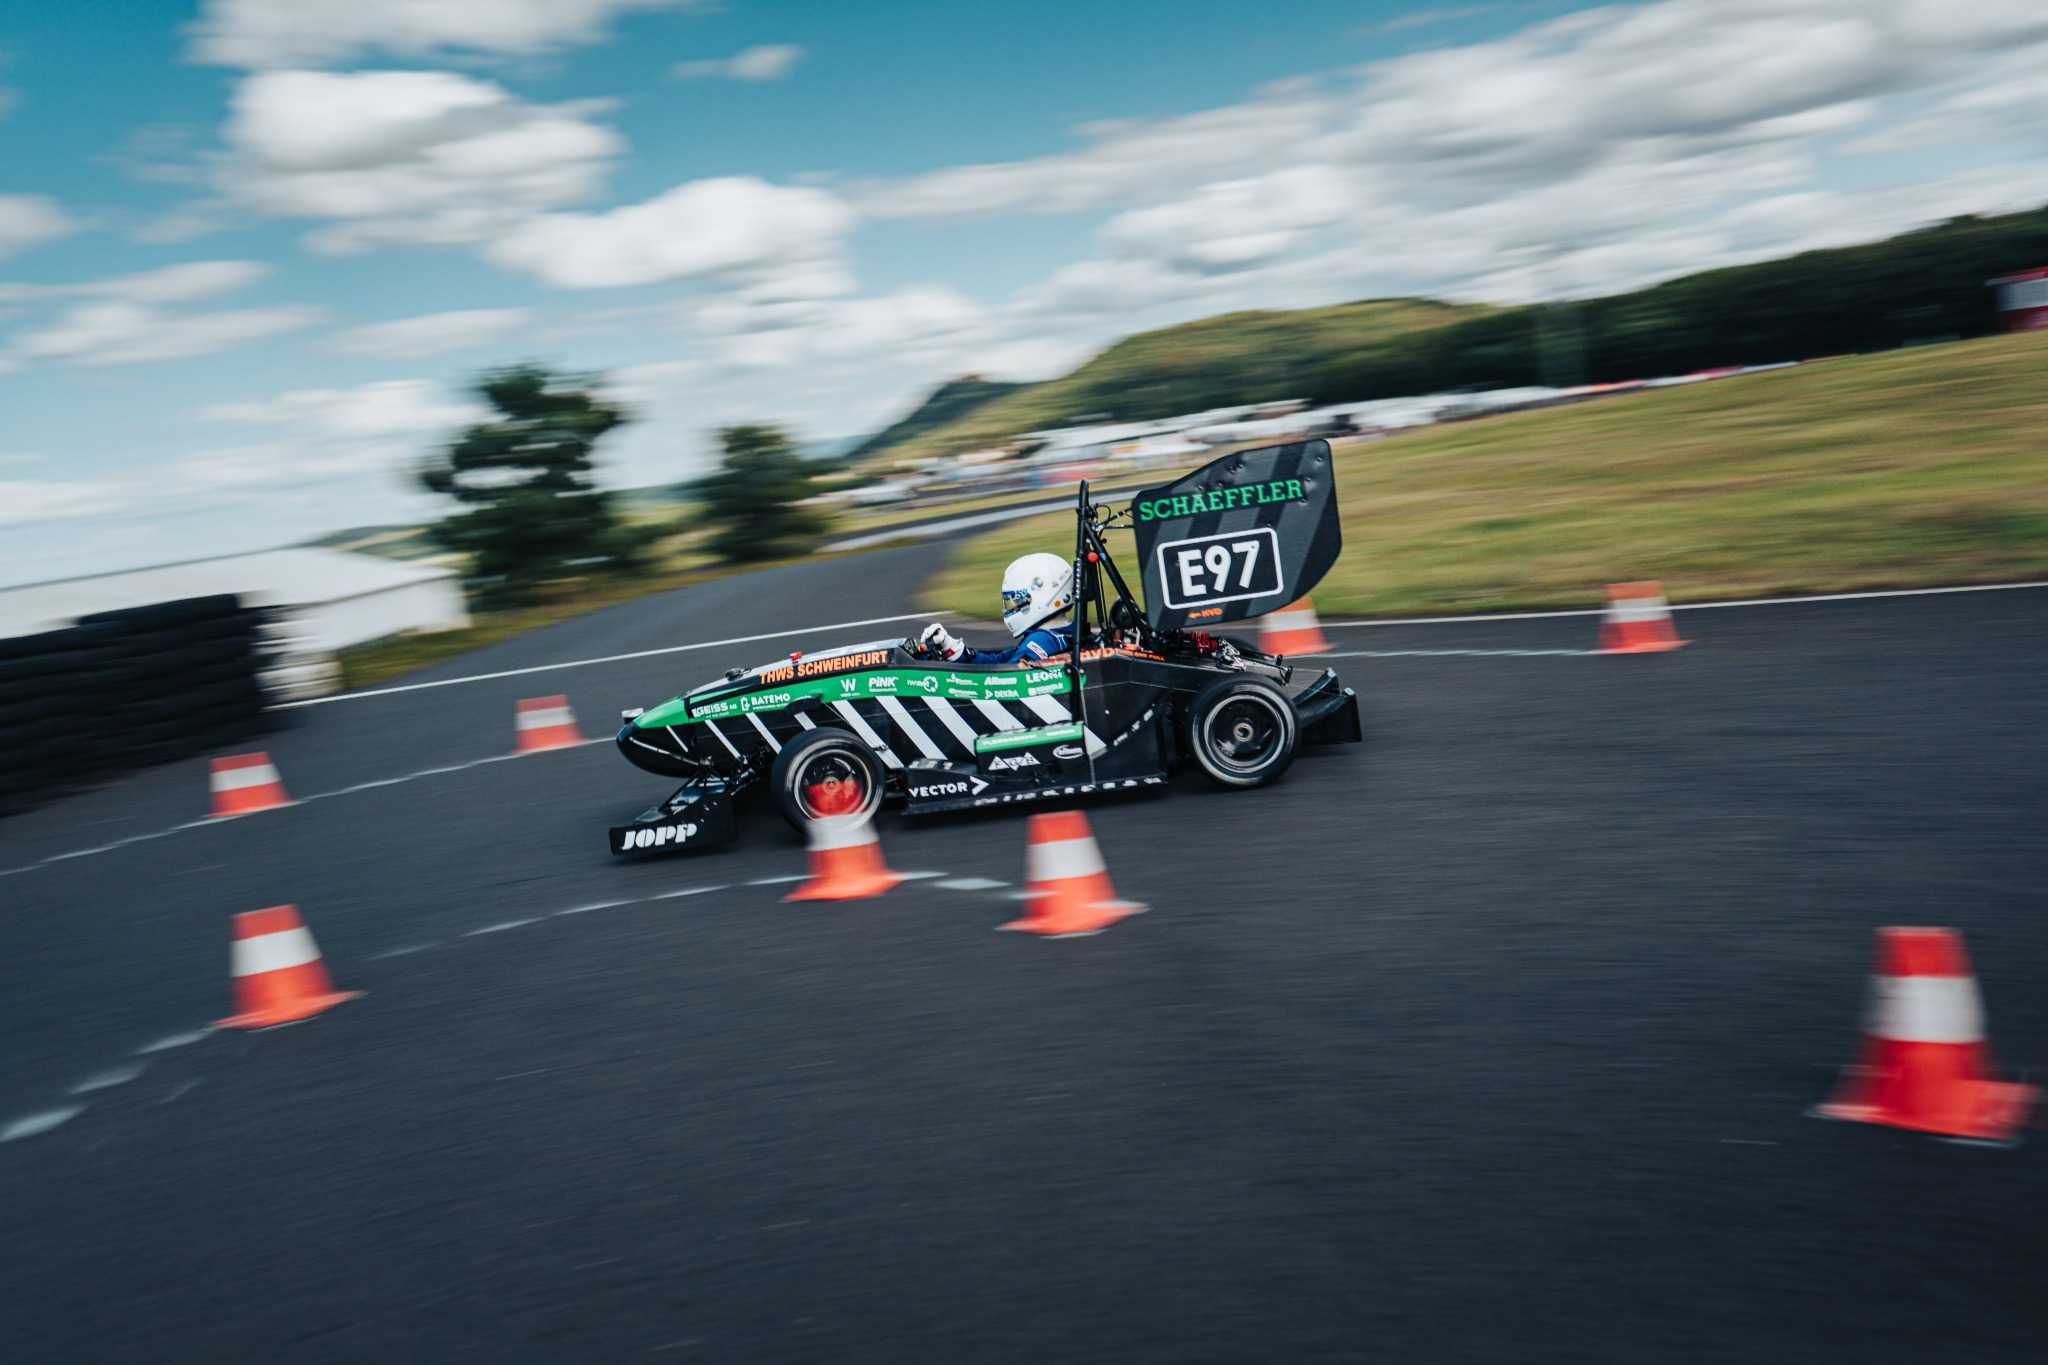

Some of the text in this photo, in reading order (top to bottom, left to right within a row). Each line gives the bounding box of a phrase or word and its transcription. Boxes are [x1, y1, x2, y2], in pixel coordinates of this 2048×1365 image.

[1139, 479, 1304, 521] SCHAEFFLER
[1178, 540, 1260, 597] E97
[759, 650, 888, 685] THWS SCHWEINFURT
[751, 693, 790, 705] BATEMO
[908, 782, 968, 798] VECTOR
[622, 823, 698, 850] JOPP
